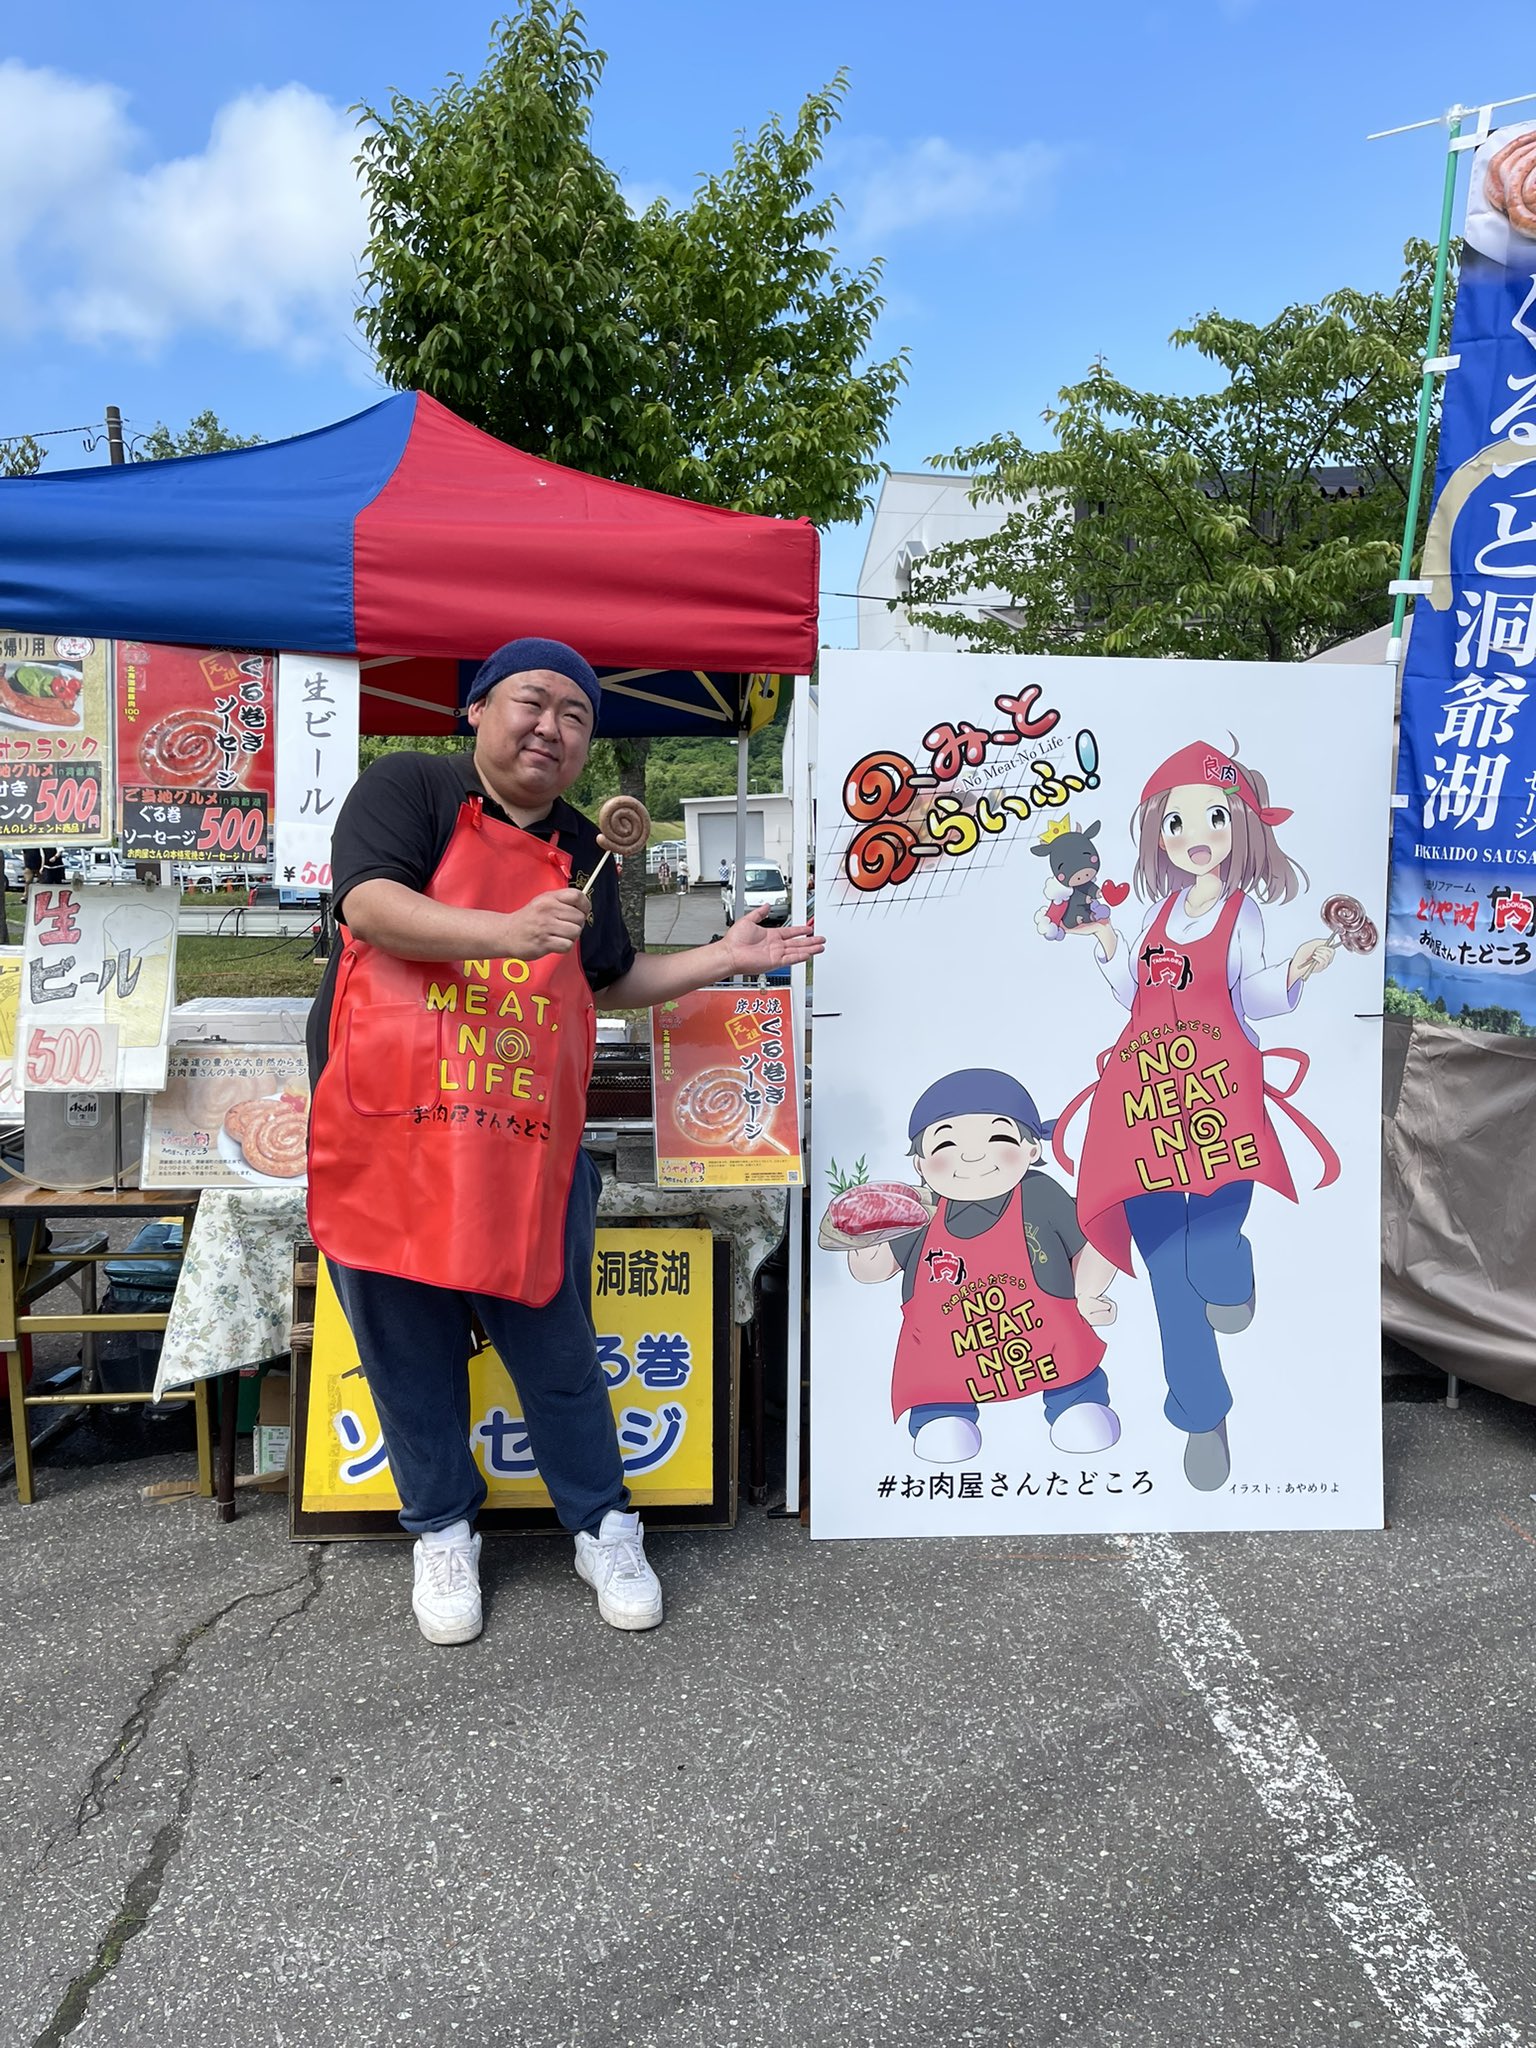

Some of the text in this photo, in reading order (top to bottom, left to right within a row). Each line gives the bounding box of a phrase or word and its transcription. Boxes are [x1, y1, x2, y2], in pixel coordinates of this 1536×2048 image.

[0, 637, 45, 658] 帰り用
[239, 657, 266, 753] ぐる巻き
[215, 695, 239, 790] ソーセージ
[300, 672, 337, 815] 生ビール
[961, 775, 982, 791] No
[1037, 735, 1065, 756] Life
[0, 823, 85, 834] んのレジェンド商品！
[123, 828, 197, 846] ソーセージ
[139, 805, 182, 823] ぐる巻
[29, 948, 142, 1005] ビール
[463, 958, 531, 984] NO
[426, 982, 559, 1033] MEAT,
[735, 998, 783, 1014] 炭火焼
[27, 1026, 102, 1085] 500
[760, 1017, 787, 1104] ぐる巻き
[1137, 1035, 1197, 1083] NO
[439, 1059, 546, 1102] LIFE.
[739, 1053, 764, 1141] ソーセージ
[1122, 1059, 1239, 1128] MEAT,
[69, 1102, 97, 1113] Asahi
[1135, 1132, 1261, 1192] LIFE
[596, 1249, 691, 1298] 洞爺湖
[952, 1299, 1043, 1357] MEAT,
[961, 1285, 1006, 1323] NO
[966, 1354, 1059, 1403] LIFE
[877, 1470, 1154, 1500] #お肉屋さんたどころ
